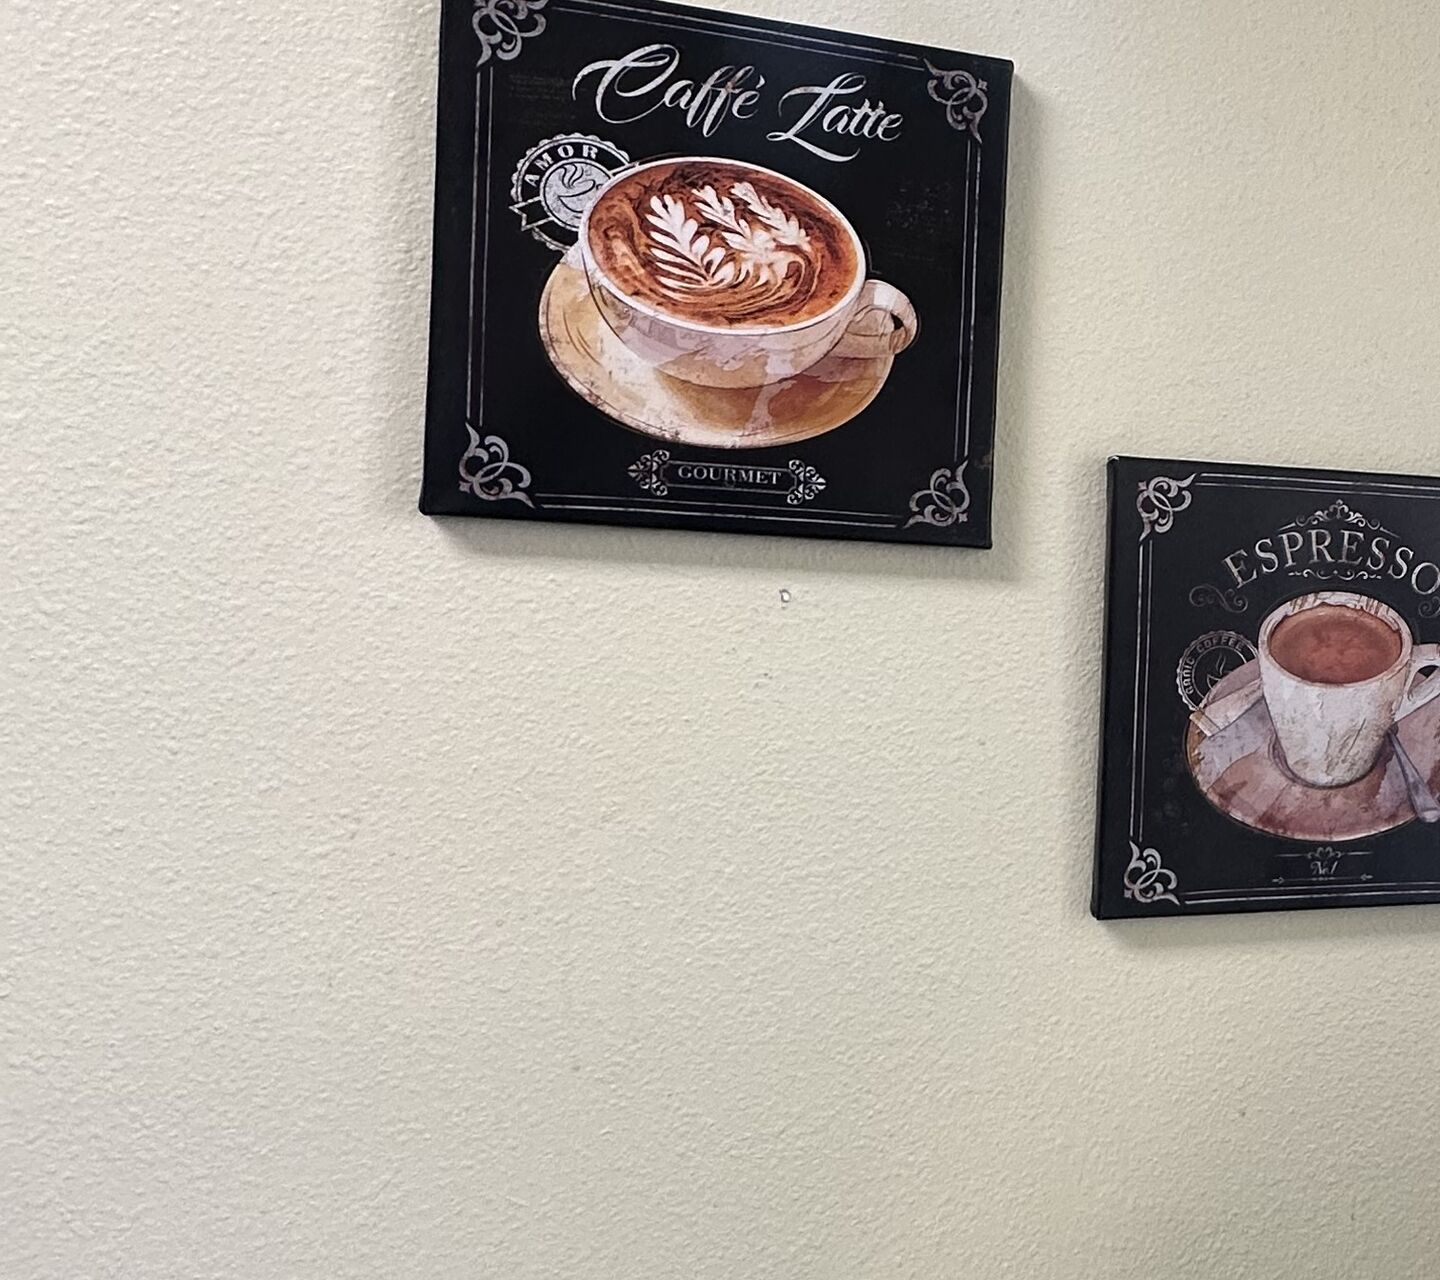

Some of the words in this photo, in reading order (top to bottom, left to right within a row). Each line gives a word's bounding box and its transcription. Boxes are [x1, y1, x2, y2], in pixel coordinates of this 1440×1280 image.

[766, 72, 903, 162] Latte
[524, 144, 599, 188] AMOR
[677, 465, 782, 485] GOURMET
[1196, 635, 1245, 653] COFFEE
